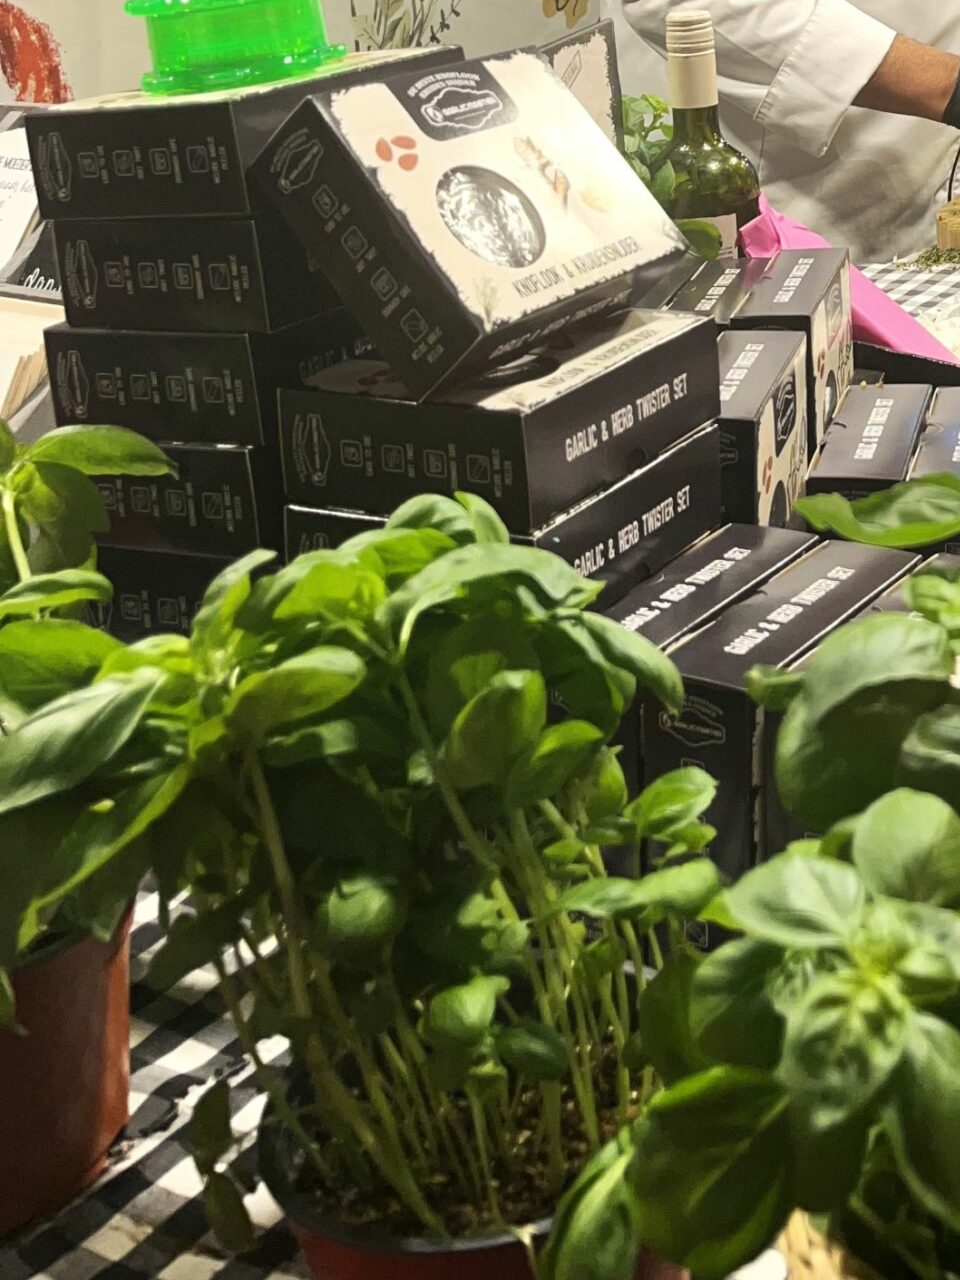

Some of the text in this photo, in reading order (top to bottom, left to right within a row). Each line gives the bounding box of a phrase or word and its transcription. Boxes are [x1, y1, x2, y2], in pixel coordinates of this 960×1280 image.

[511, 265, 565, 299] KNOFLOOK
[565, 423, 598, 462] GARLIC
[601, 420, 609, 442] &
[611, 404, 634, 438] HERB
[636, 383, 671, 421] TWISTER
[673, 372, 688, 400] SET
[608, 538, 615, 559] &
[618, 520, 640, 554] HERB
[641, 496, 674, 536] TWISTER
[676, 485, 690, 513] SET
